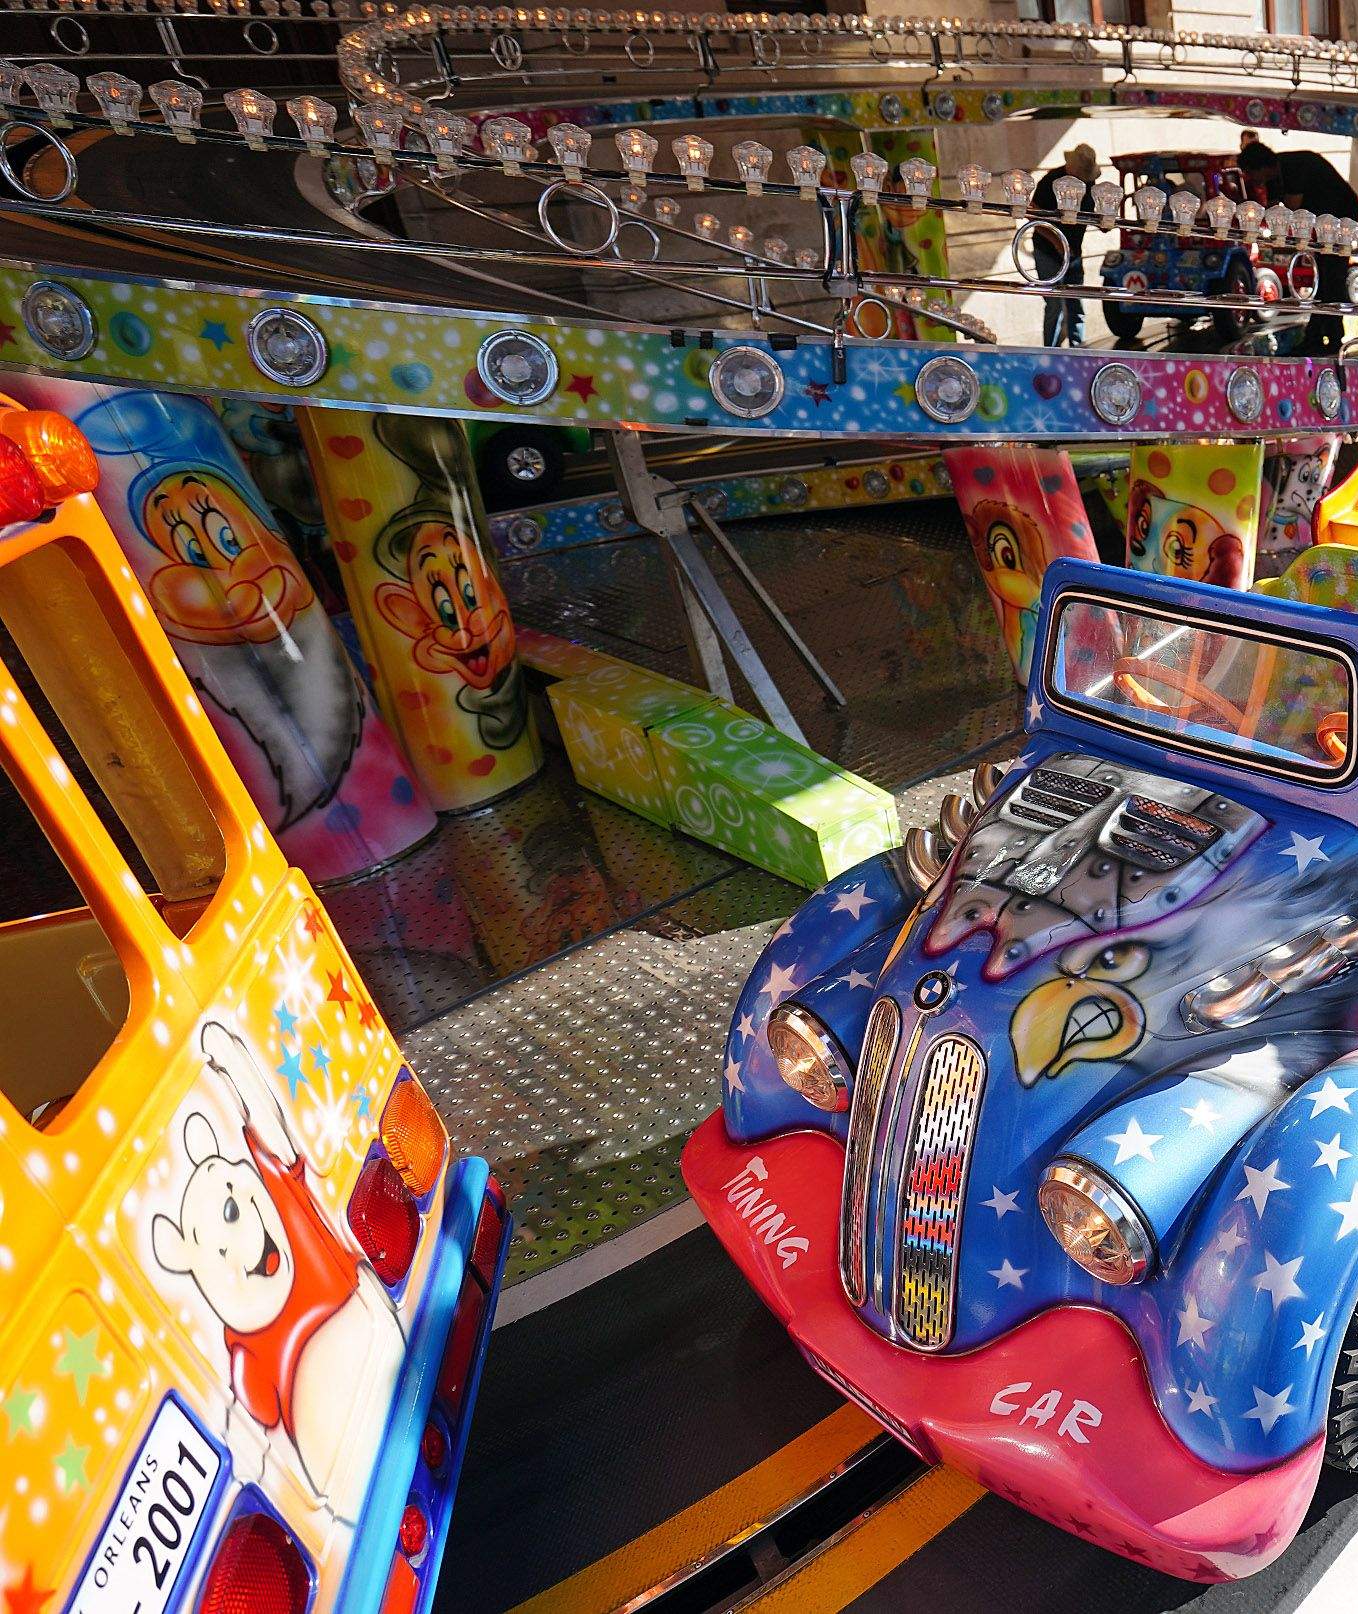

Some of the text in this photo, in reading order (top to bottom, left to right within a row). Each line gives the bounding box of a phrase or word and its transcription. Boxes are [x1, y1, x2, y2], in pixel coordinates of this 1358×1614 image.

[719, 1155, 810, 1270] TUNING
[989, 1381, 1103, 1444] CAR
[94, 1454, 158, 1588] ORLEANS
[132, 1440, 207, 1590] 2001
